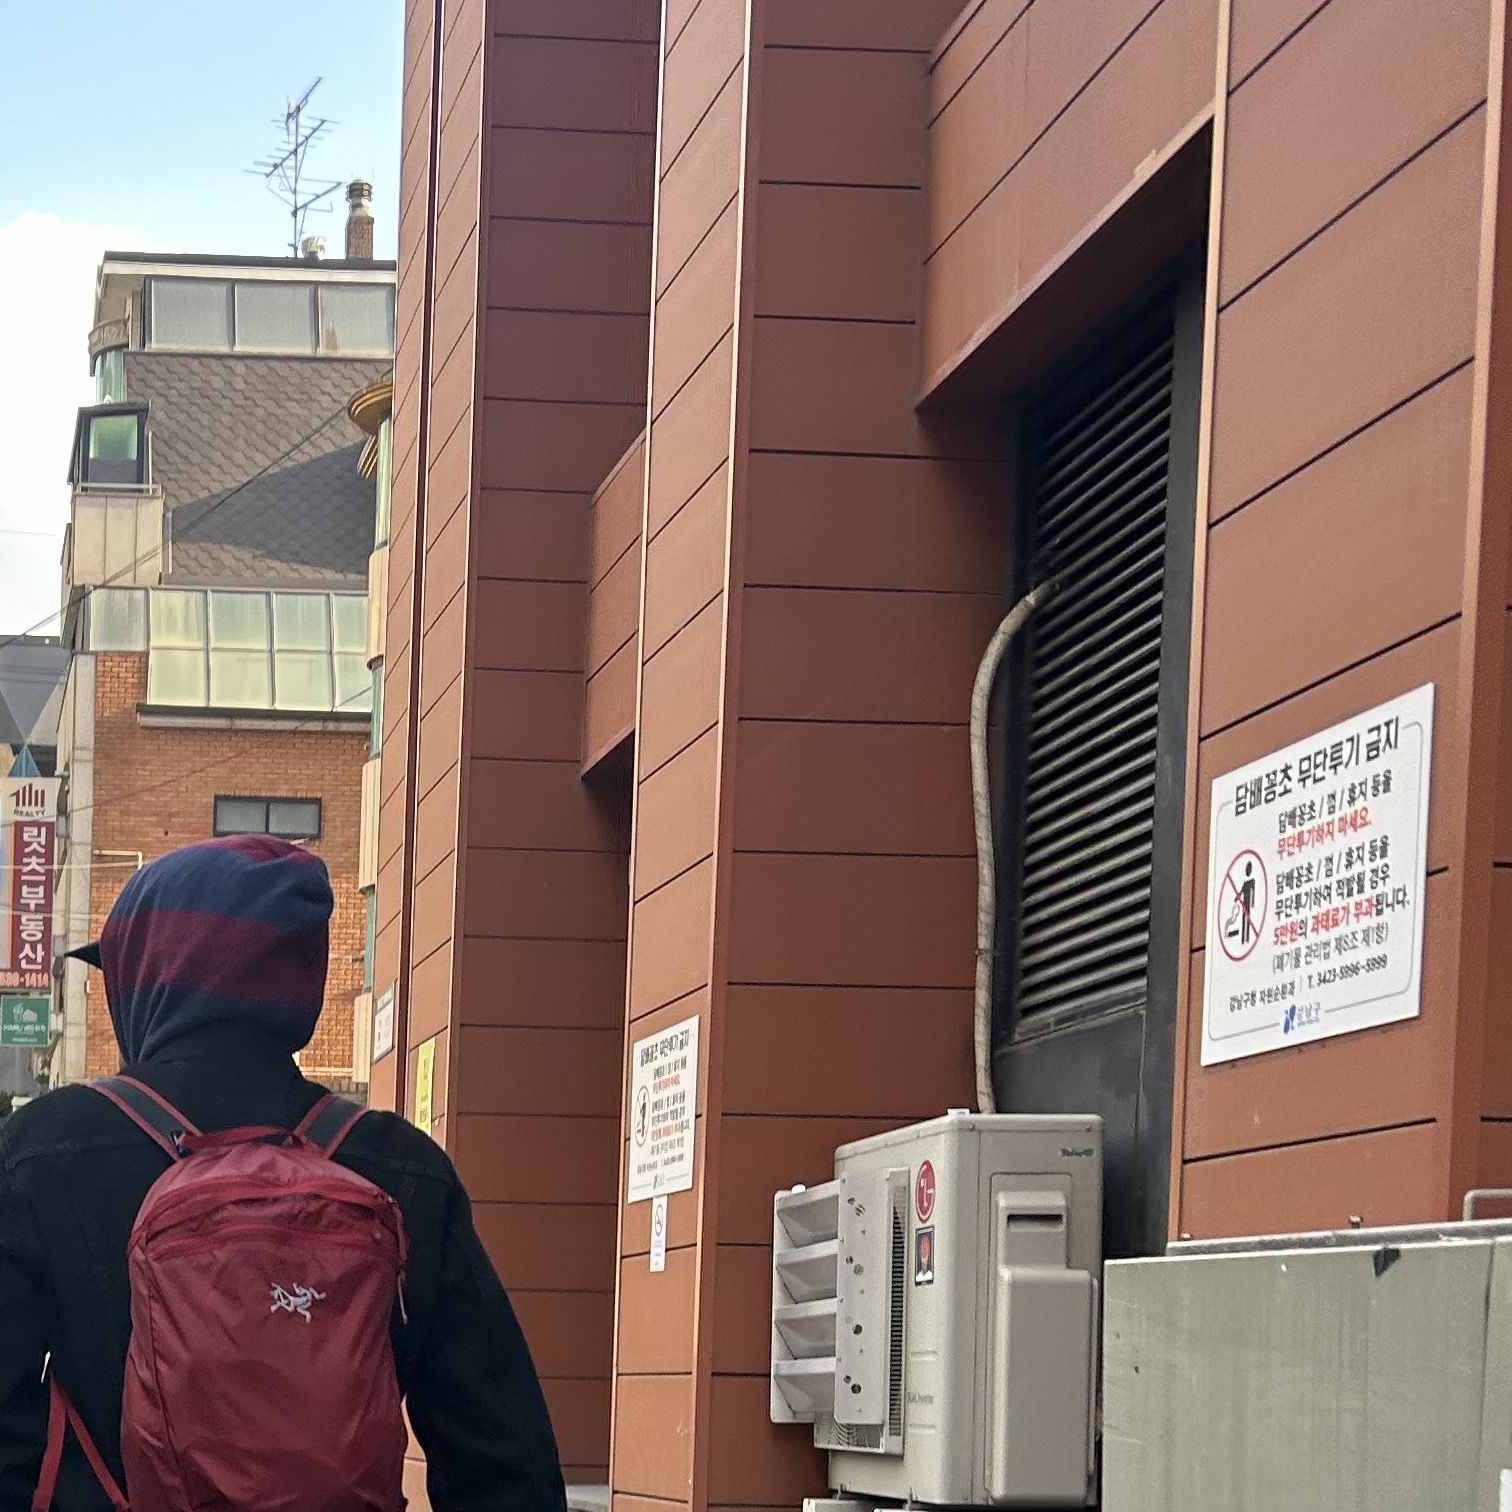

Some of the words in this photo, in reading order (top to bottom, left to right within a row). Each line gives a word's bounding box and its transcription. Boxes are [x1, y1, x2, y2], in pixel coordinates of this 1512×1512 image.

[1235, 762, 1293, 817] 담배꽁초
[1298, 733, 1360, 788] 무단투기
[1366, 716, 1399, 762] 금지
[13, 809, 46, 817] REALTY
[1278, 800, 1316, 833] 담배꽁초
[1347, 777, 1368, 807] 휴지
[1371, 769, 1392, 798] 등을
[1277, 817, 1334, 860] 무단투기하지
[1338, 806, 1372, 837] 마세요.
[1275, 881, 1332, 922] 무단투기하여
[1370, 863, 1390, 890] 경우
[1277, 862, 1313, 895] 담배꽁초
[1344, 842, 1365, 871] 휴지
[1369, 834, 1389, 862] 등을
[18, 826, 47, 970] 릿츠부동산
